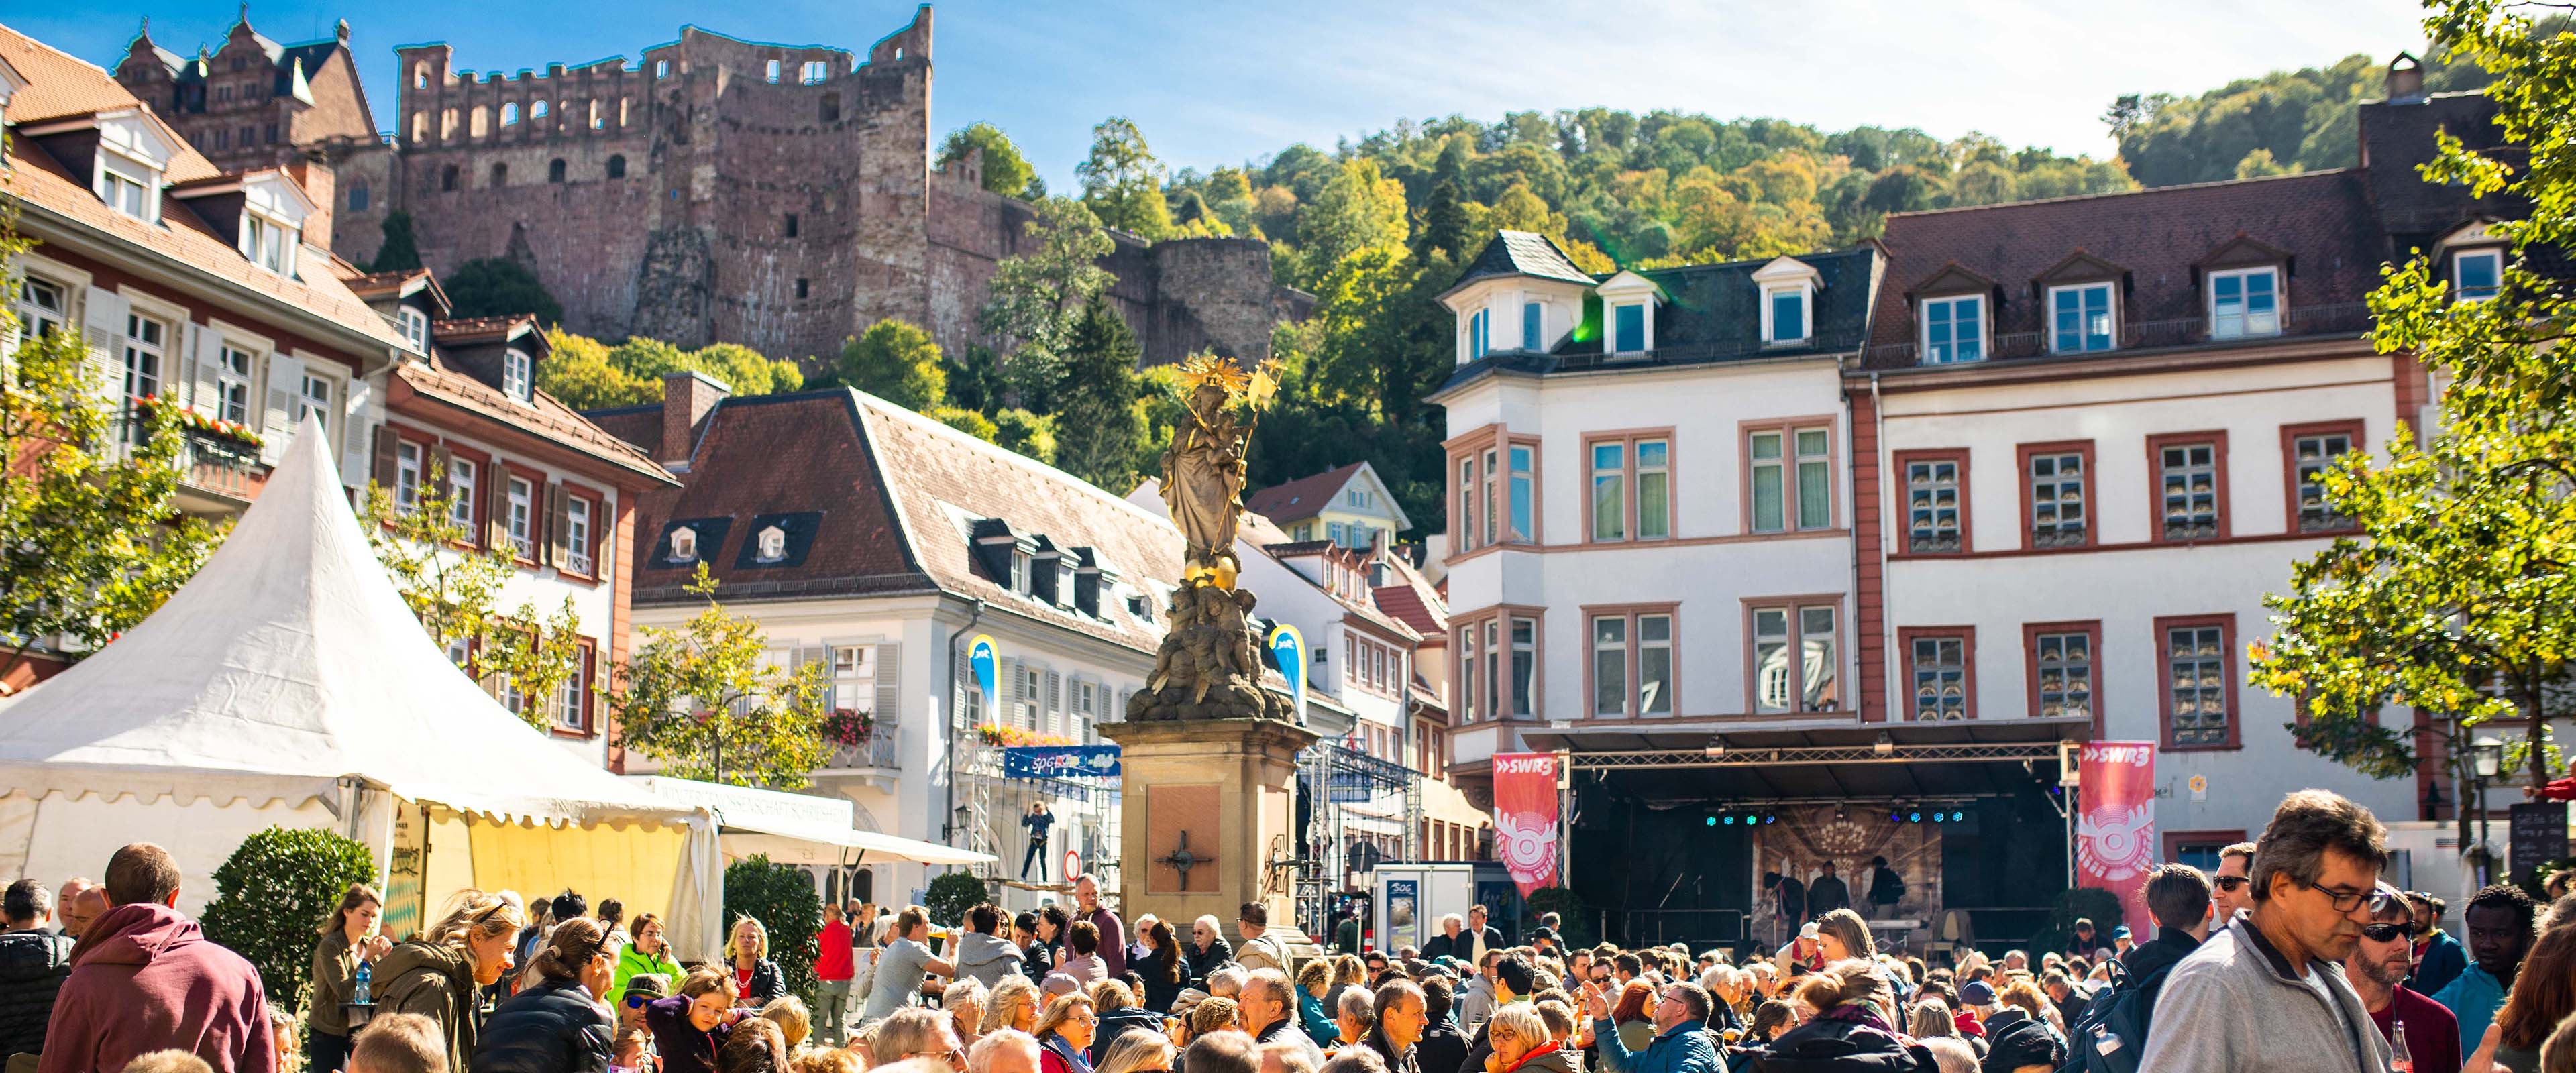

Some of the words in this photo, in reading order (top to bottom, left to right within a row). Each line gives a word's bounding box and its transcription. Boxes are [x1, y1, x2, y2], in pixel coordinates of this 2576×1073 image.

[2098, 746, 2149, 767] SWR3
[1509, 757, 1552, 776] SWR3
[1394, 883, 1412, 892] SOG
